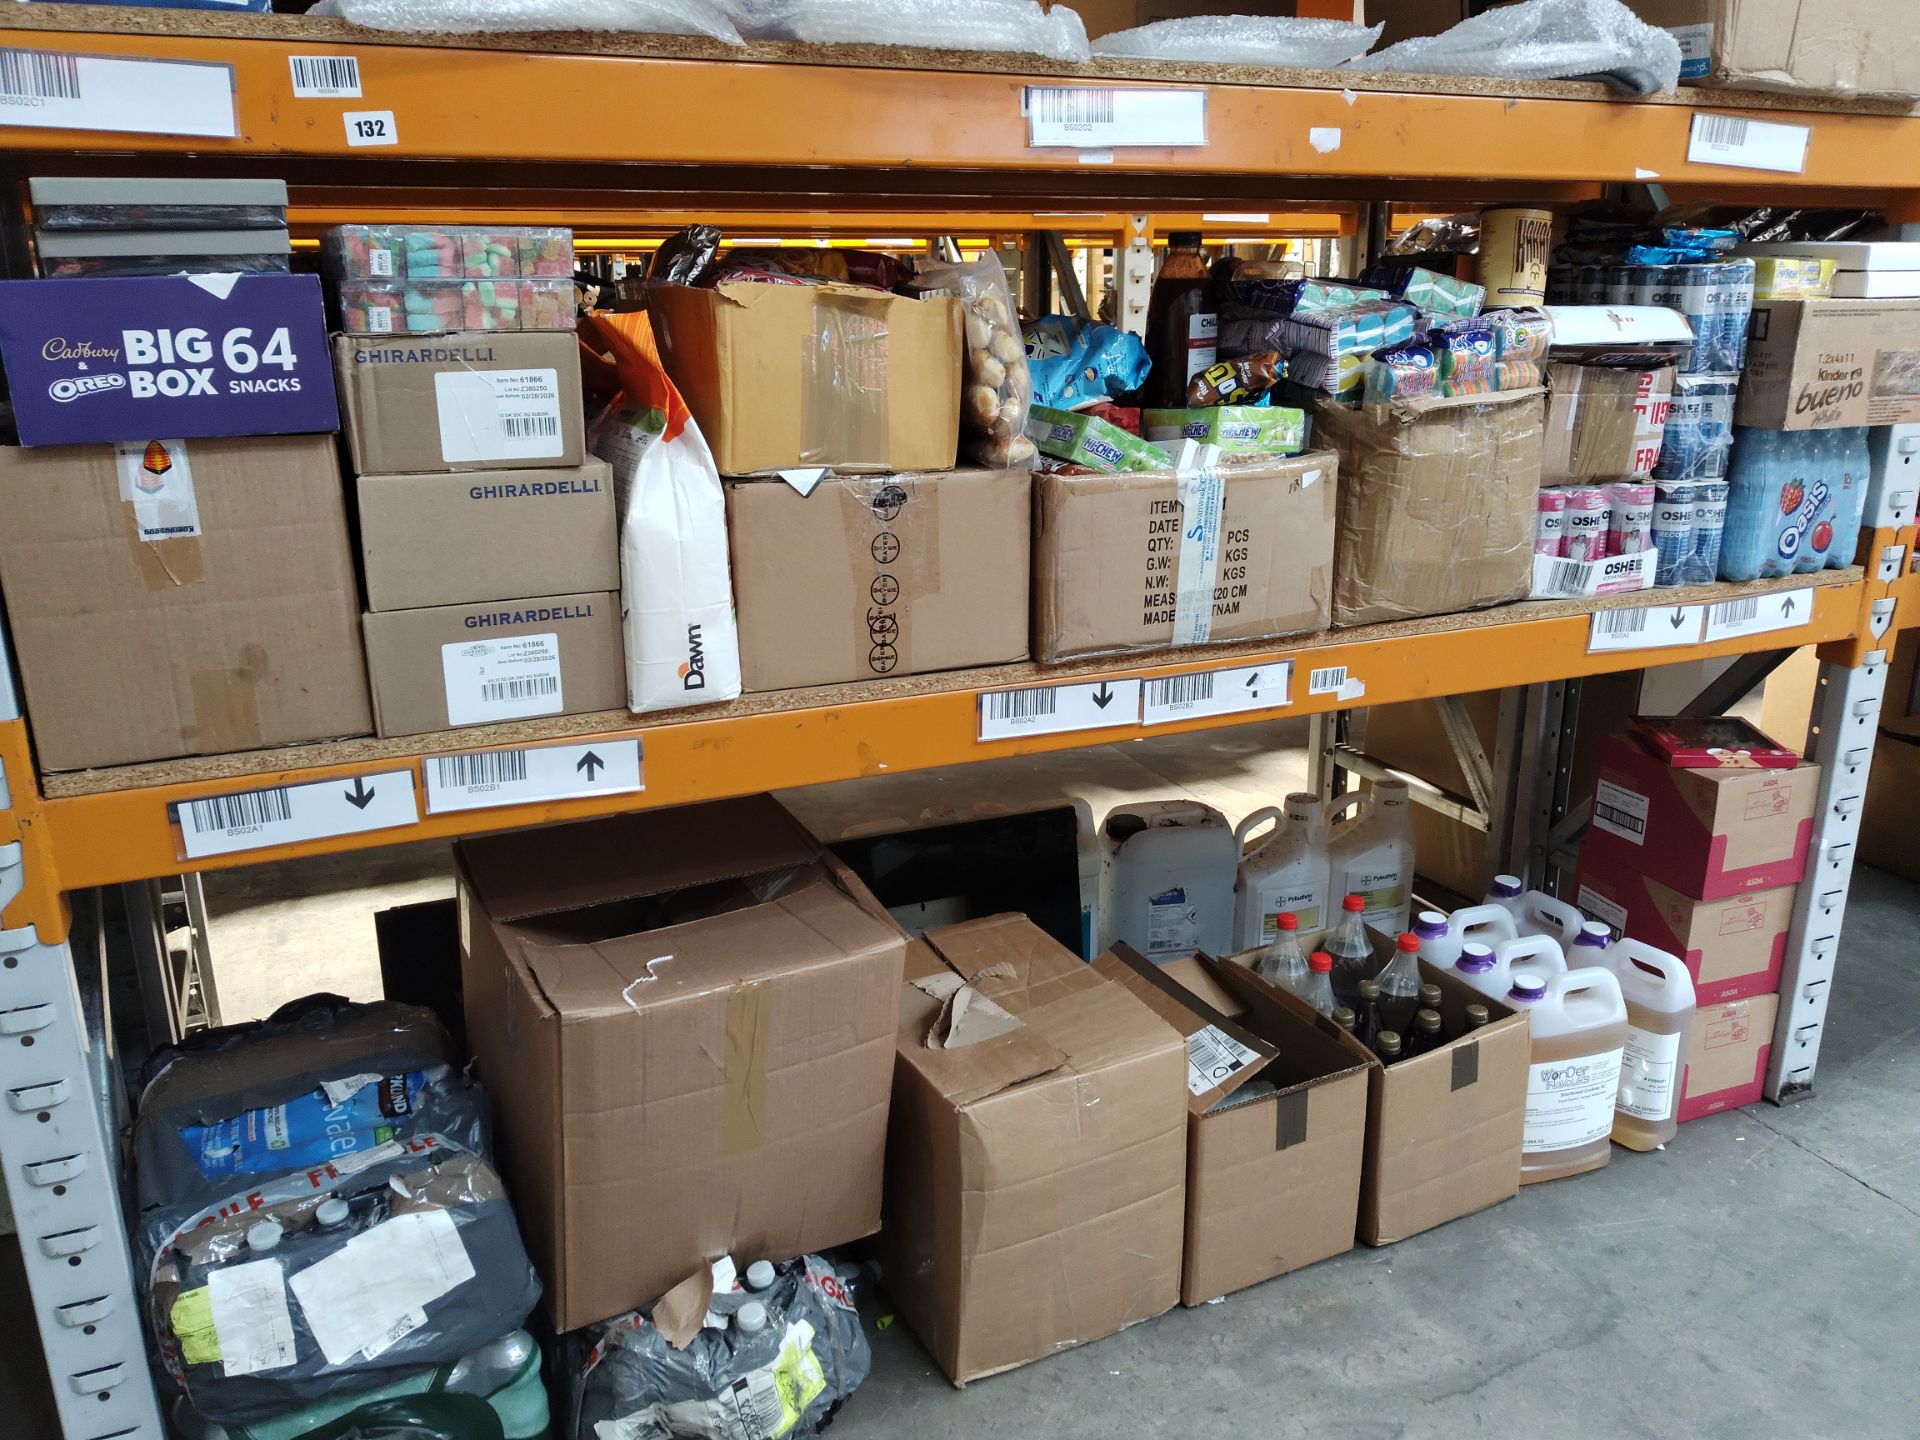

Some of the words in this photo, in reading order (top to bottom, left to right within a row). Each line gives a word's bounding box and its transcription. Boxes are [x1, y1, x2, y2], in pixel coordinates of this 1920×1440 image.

[355, 120, 386, 137] 132
[42, 337, 119, 362] Cadbury
[122, 328, 213, 364] BIG
[222, 327, 297, 374] 64
[354, 348, 494, 363] GHIRARDELLI
[78, 361, 88, 370] &
[51, 375, 124, 399] OREO
[129, 368, 219, 398] BOX
[229, 378, 301, 394] SNACKS
[1795, 381, 1864, 414] bueno
[1083, 437, 1125, 463] HI-CHEW
[469, 479, 600, 500] GHIRARDELLI
[1150, 500, 1178, 514] ITEM
[1149, 519, 1179, 534] DATE
[1778, 479, 1828, 559] Oasis
[1227, 529, 1249, 544] PCS
[1148, 538, 1174, 552] QTY:
[1225, 548, 1248, 562] KGS
[1146, 557, 1171, 571] G.W:
[1604, 559, 1644, 575] OSHEE
[1223, 566, 1246, 581] KGS
[1145, 575, 1169, 589] N.W:
[1231, 584, 1248, 598] CM
[464, 605, 592, 628] GHIRARDELLI
[1143, 610, 1175, 625] MADE
[522, 640, 545, 649] 61866
[683, 624, 705, 690] Dawn
[1169, 702, 1194, 711] BS02B2
[1010, 716, 1036, 726] BS02A2
[467, 783, 500, 794] BS02B1
[227, 825, 264, 837] BS02A1
[1746, 877, 1764, 887] ASDA
